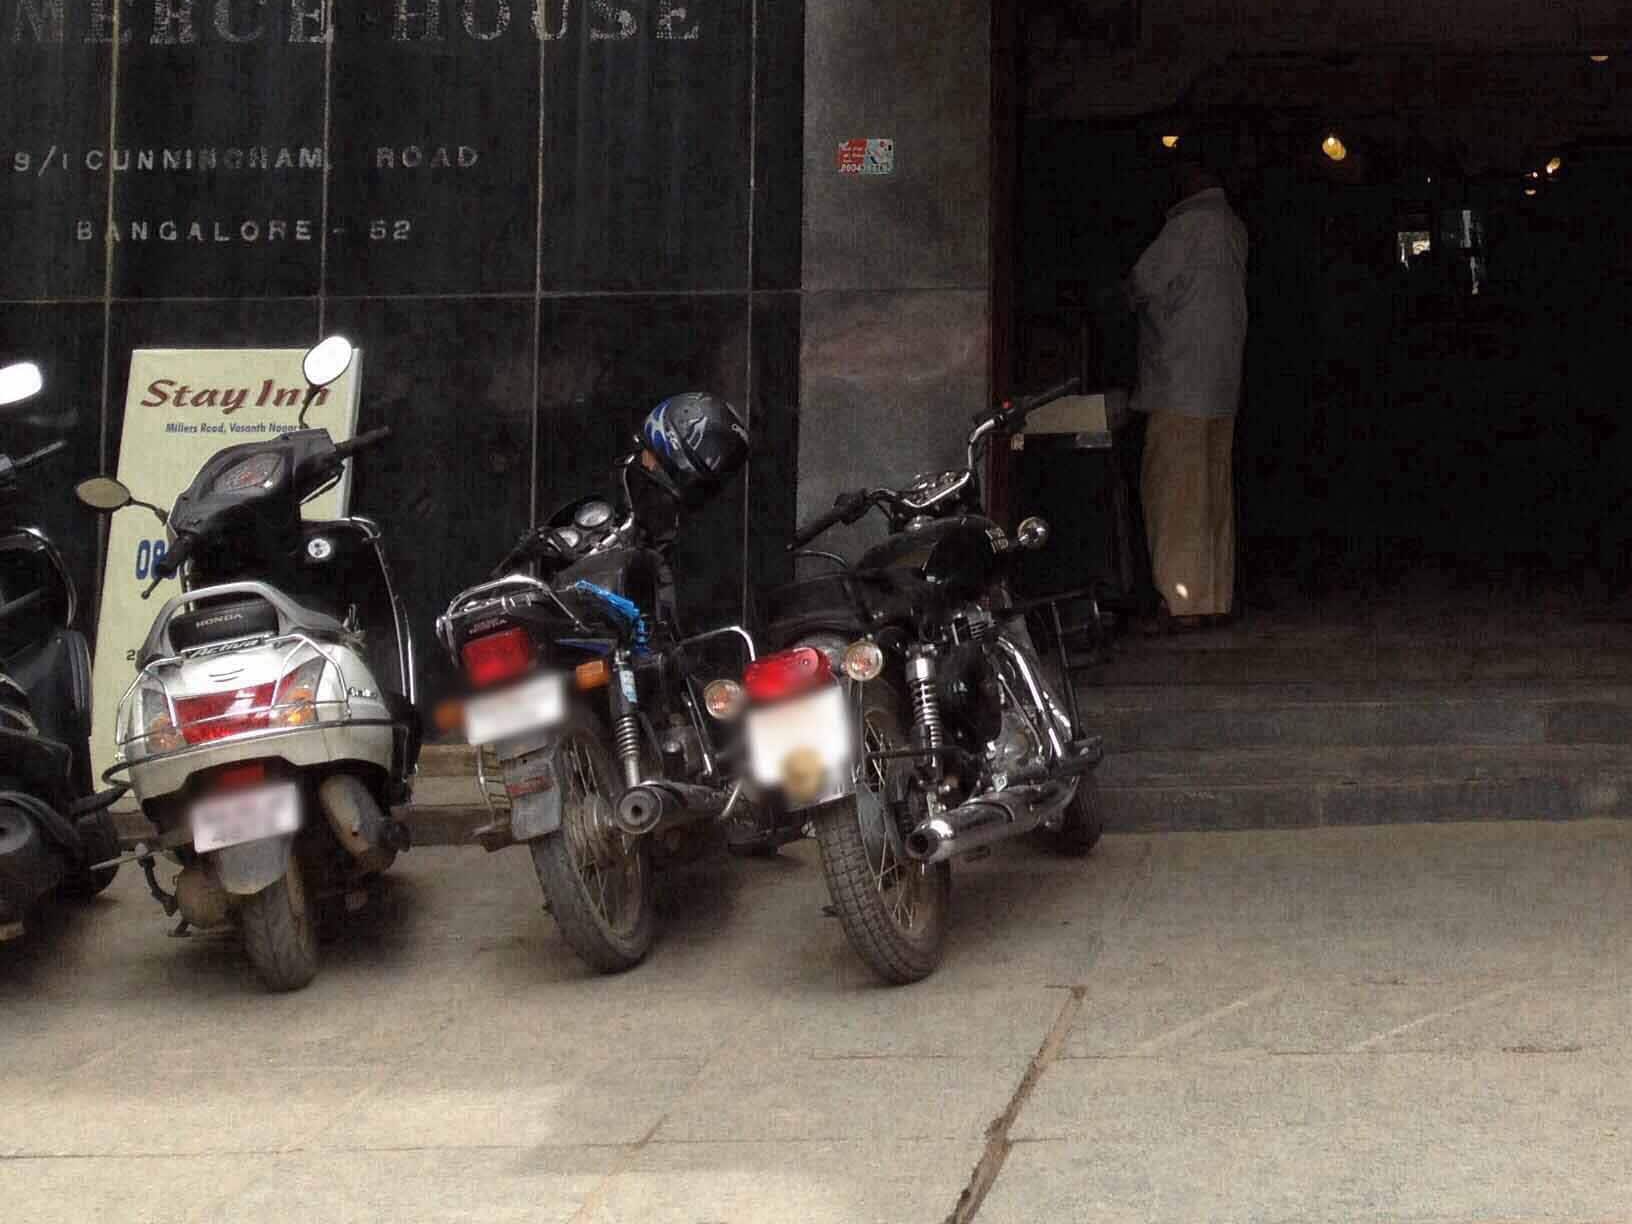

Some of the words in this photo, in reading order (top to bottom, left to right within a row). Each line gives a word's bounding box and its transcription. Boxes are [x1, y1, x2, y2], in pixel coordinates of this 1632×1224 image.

[376, 144, 480, 169] ROAD
[76, 219, 313, 242] BANGALORE
[369, 219, 412, 240] 52
[140, 379, 250, 415] Stay
[255, 379, 331, 407] Inn
[229, 422, 266, 433] Vasanth
